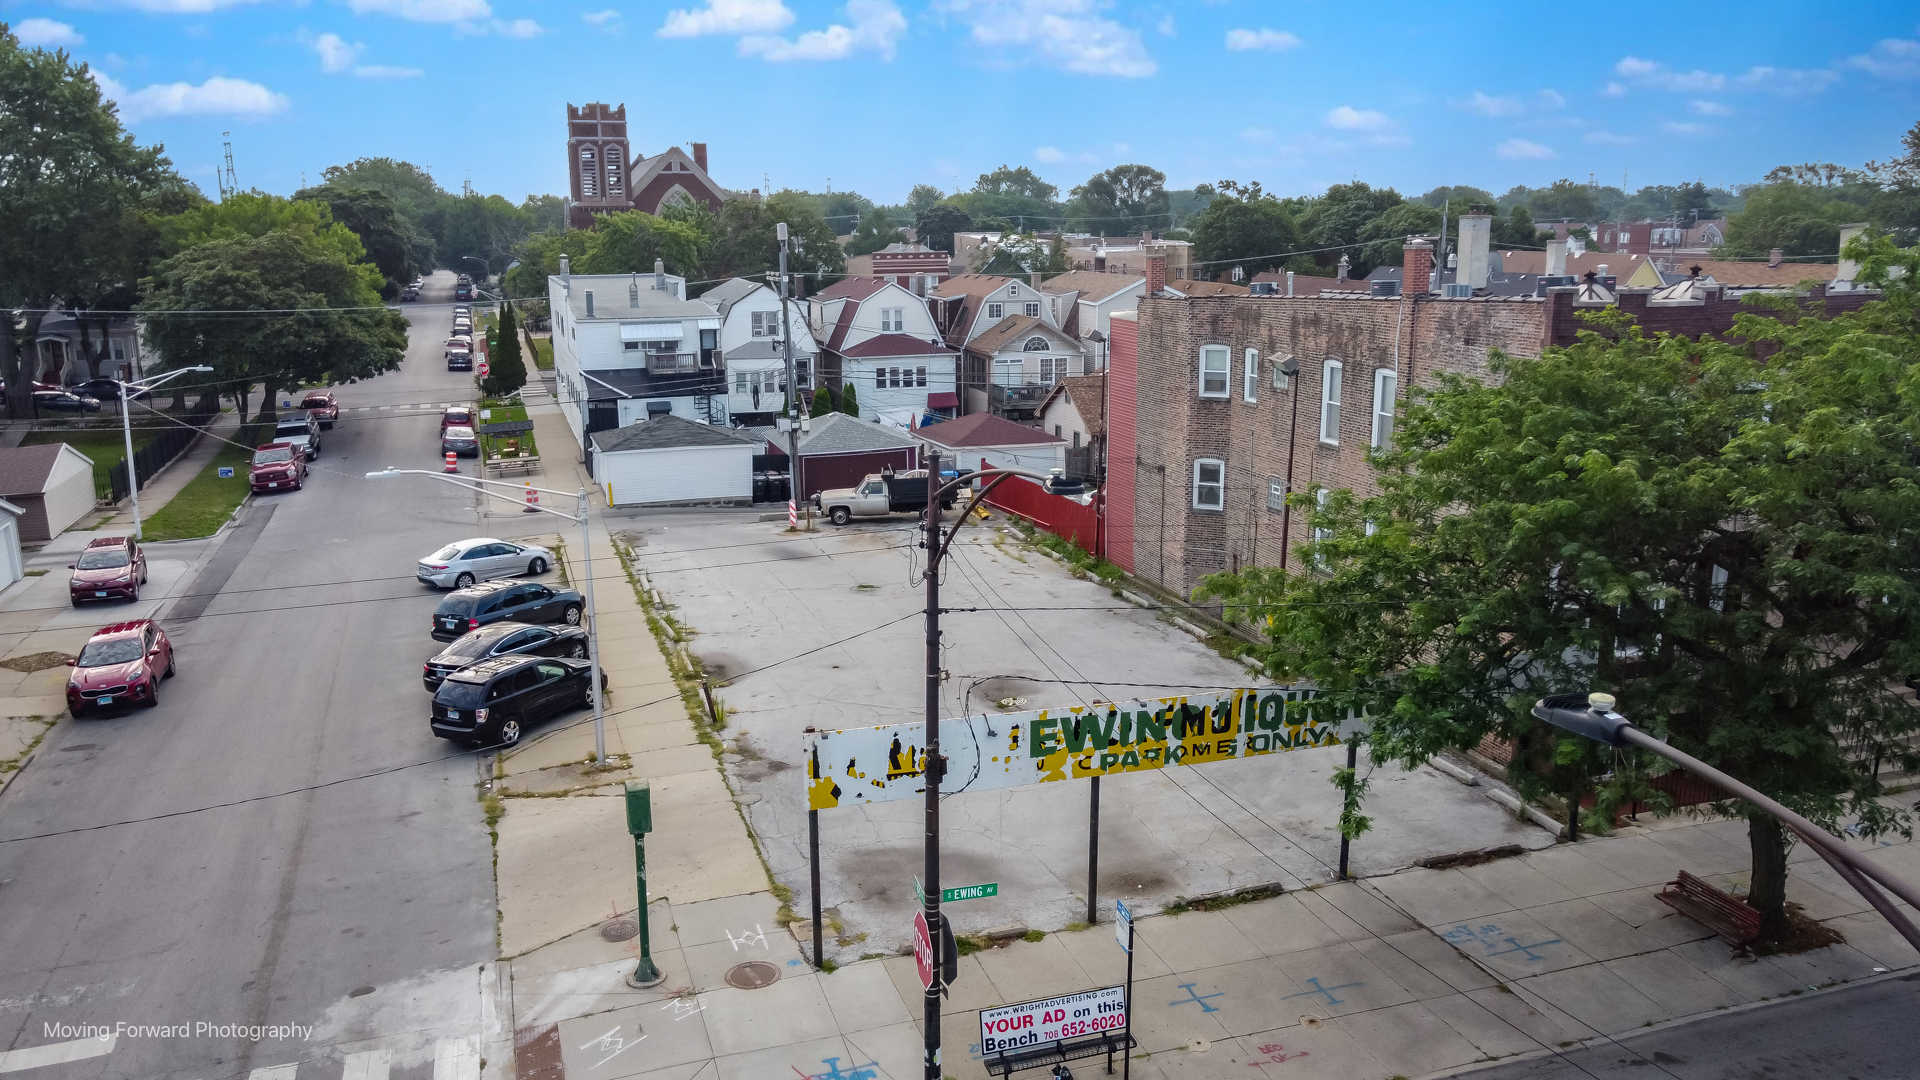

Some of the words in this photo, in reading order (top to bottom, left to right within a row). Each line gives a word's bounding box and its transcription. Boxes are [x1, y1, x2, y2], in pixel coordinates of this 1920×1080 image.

[1251, 725, 1330, 752] ONLY
[954, 886, 983, 900] EWING
[986, 886, 994, 894] AV
[914, 926, 932, 972] STOP
[984, 1014, 1034, 1035] YOUR
[1042, 1008, 1066, 1025] AD
[1073, 1006, 1091, 1018] on
[1097, 1000, 1124, 1014] this
[988, 989, 1118, 1018] www.WRIGHTADVERTISING.com
[985, 1030, 1038, 1052] Bench
[1043, 1030, 1059, 1040] 708
[1061, 1013, 1125, 1037] 652-6020
